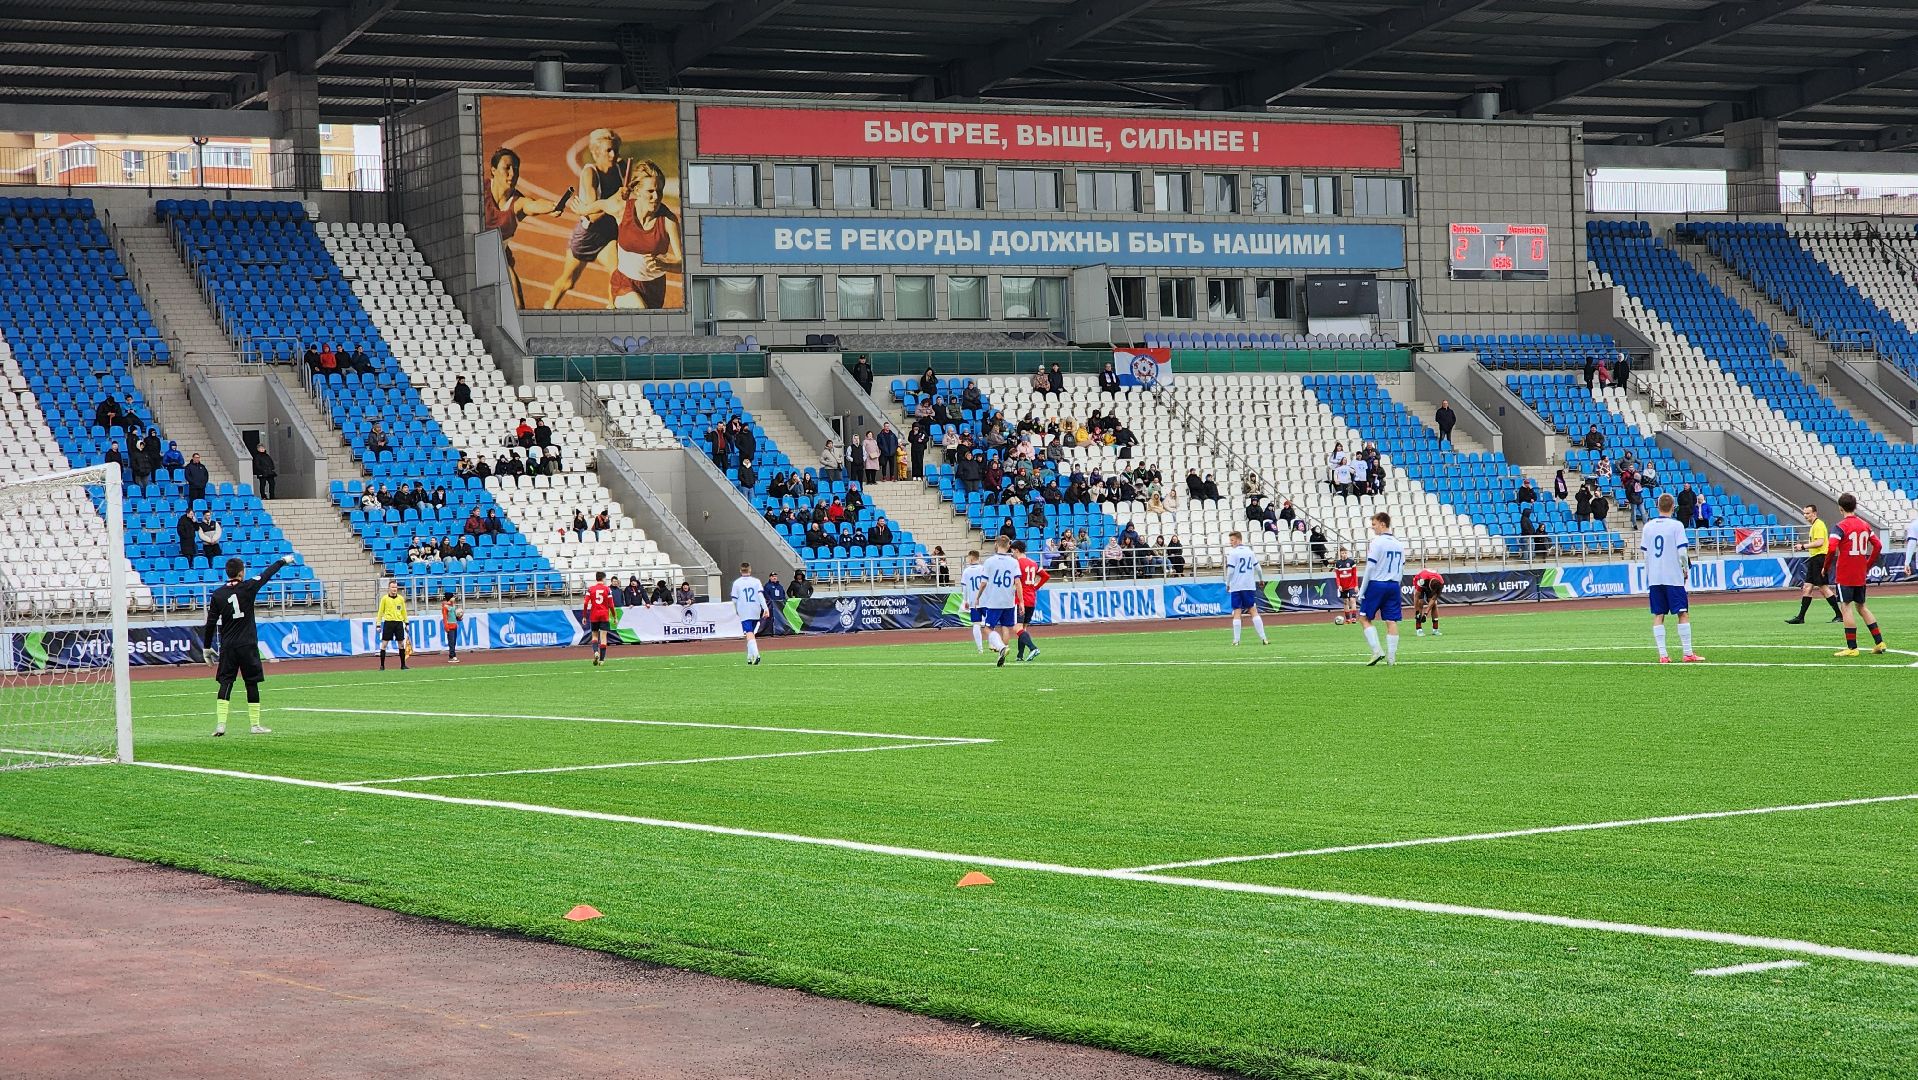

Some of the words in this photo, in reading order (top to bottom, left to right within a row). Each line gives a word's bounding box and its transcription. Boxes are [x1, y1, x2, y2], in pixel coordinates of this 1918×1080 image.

[864, 121, 1008, 150] БЫСТРЕЕ,
[1017, 125, 1112, 152] ВЫШЕ,
[1120, 127, 1245, 152] СИЛЬНЕЕ
[774, 228, 832, 250] ВСЕ
[841, 229, 981, 256] РЕКОРДЫ
[989, 231, 1120, 256] ДОЛЖНЫ
[1128, 232, 1205, 254] БЫТЬ
[1213, 234, 1331, 255] НАШИМИ
[1455, 237, 1469, 260] 2
[1531, 238, 1545, 261] 0
[1654, 534, 1665, 558] 9
[1848, 531, 1870, 556] 10
[1238, 556, 1253, 574] 24
[1386, 550, 1402, 574] 77
[993, 568, 1012, 588] 46
[1024, 565, 1036, 585] 11
[742, 587, 756, 602] 12
[1465, 582, 1488, 592] ЛИГА
[1498, 580, 1530, 592] ЦЕНТР
[227, 593, 245, 620] 1
[595, 589, 605, 605] 5
[861, 598, 907, 607] РОССИЙСКИЙ
[1059, 588, 1157, 620] ГАЗПРОМ
[861, 606, 910, 616] ФУТБОЛЬНЫЙ
[861, 617, 882, 625] СОЮЗ
[300, 641, 342, 655] ГАЗПРОМ
[516, 632, 557, 645] ГАЗПРОМ
